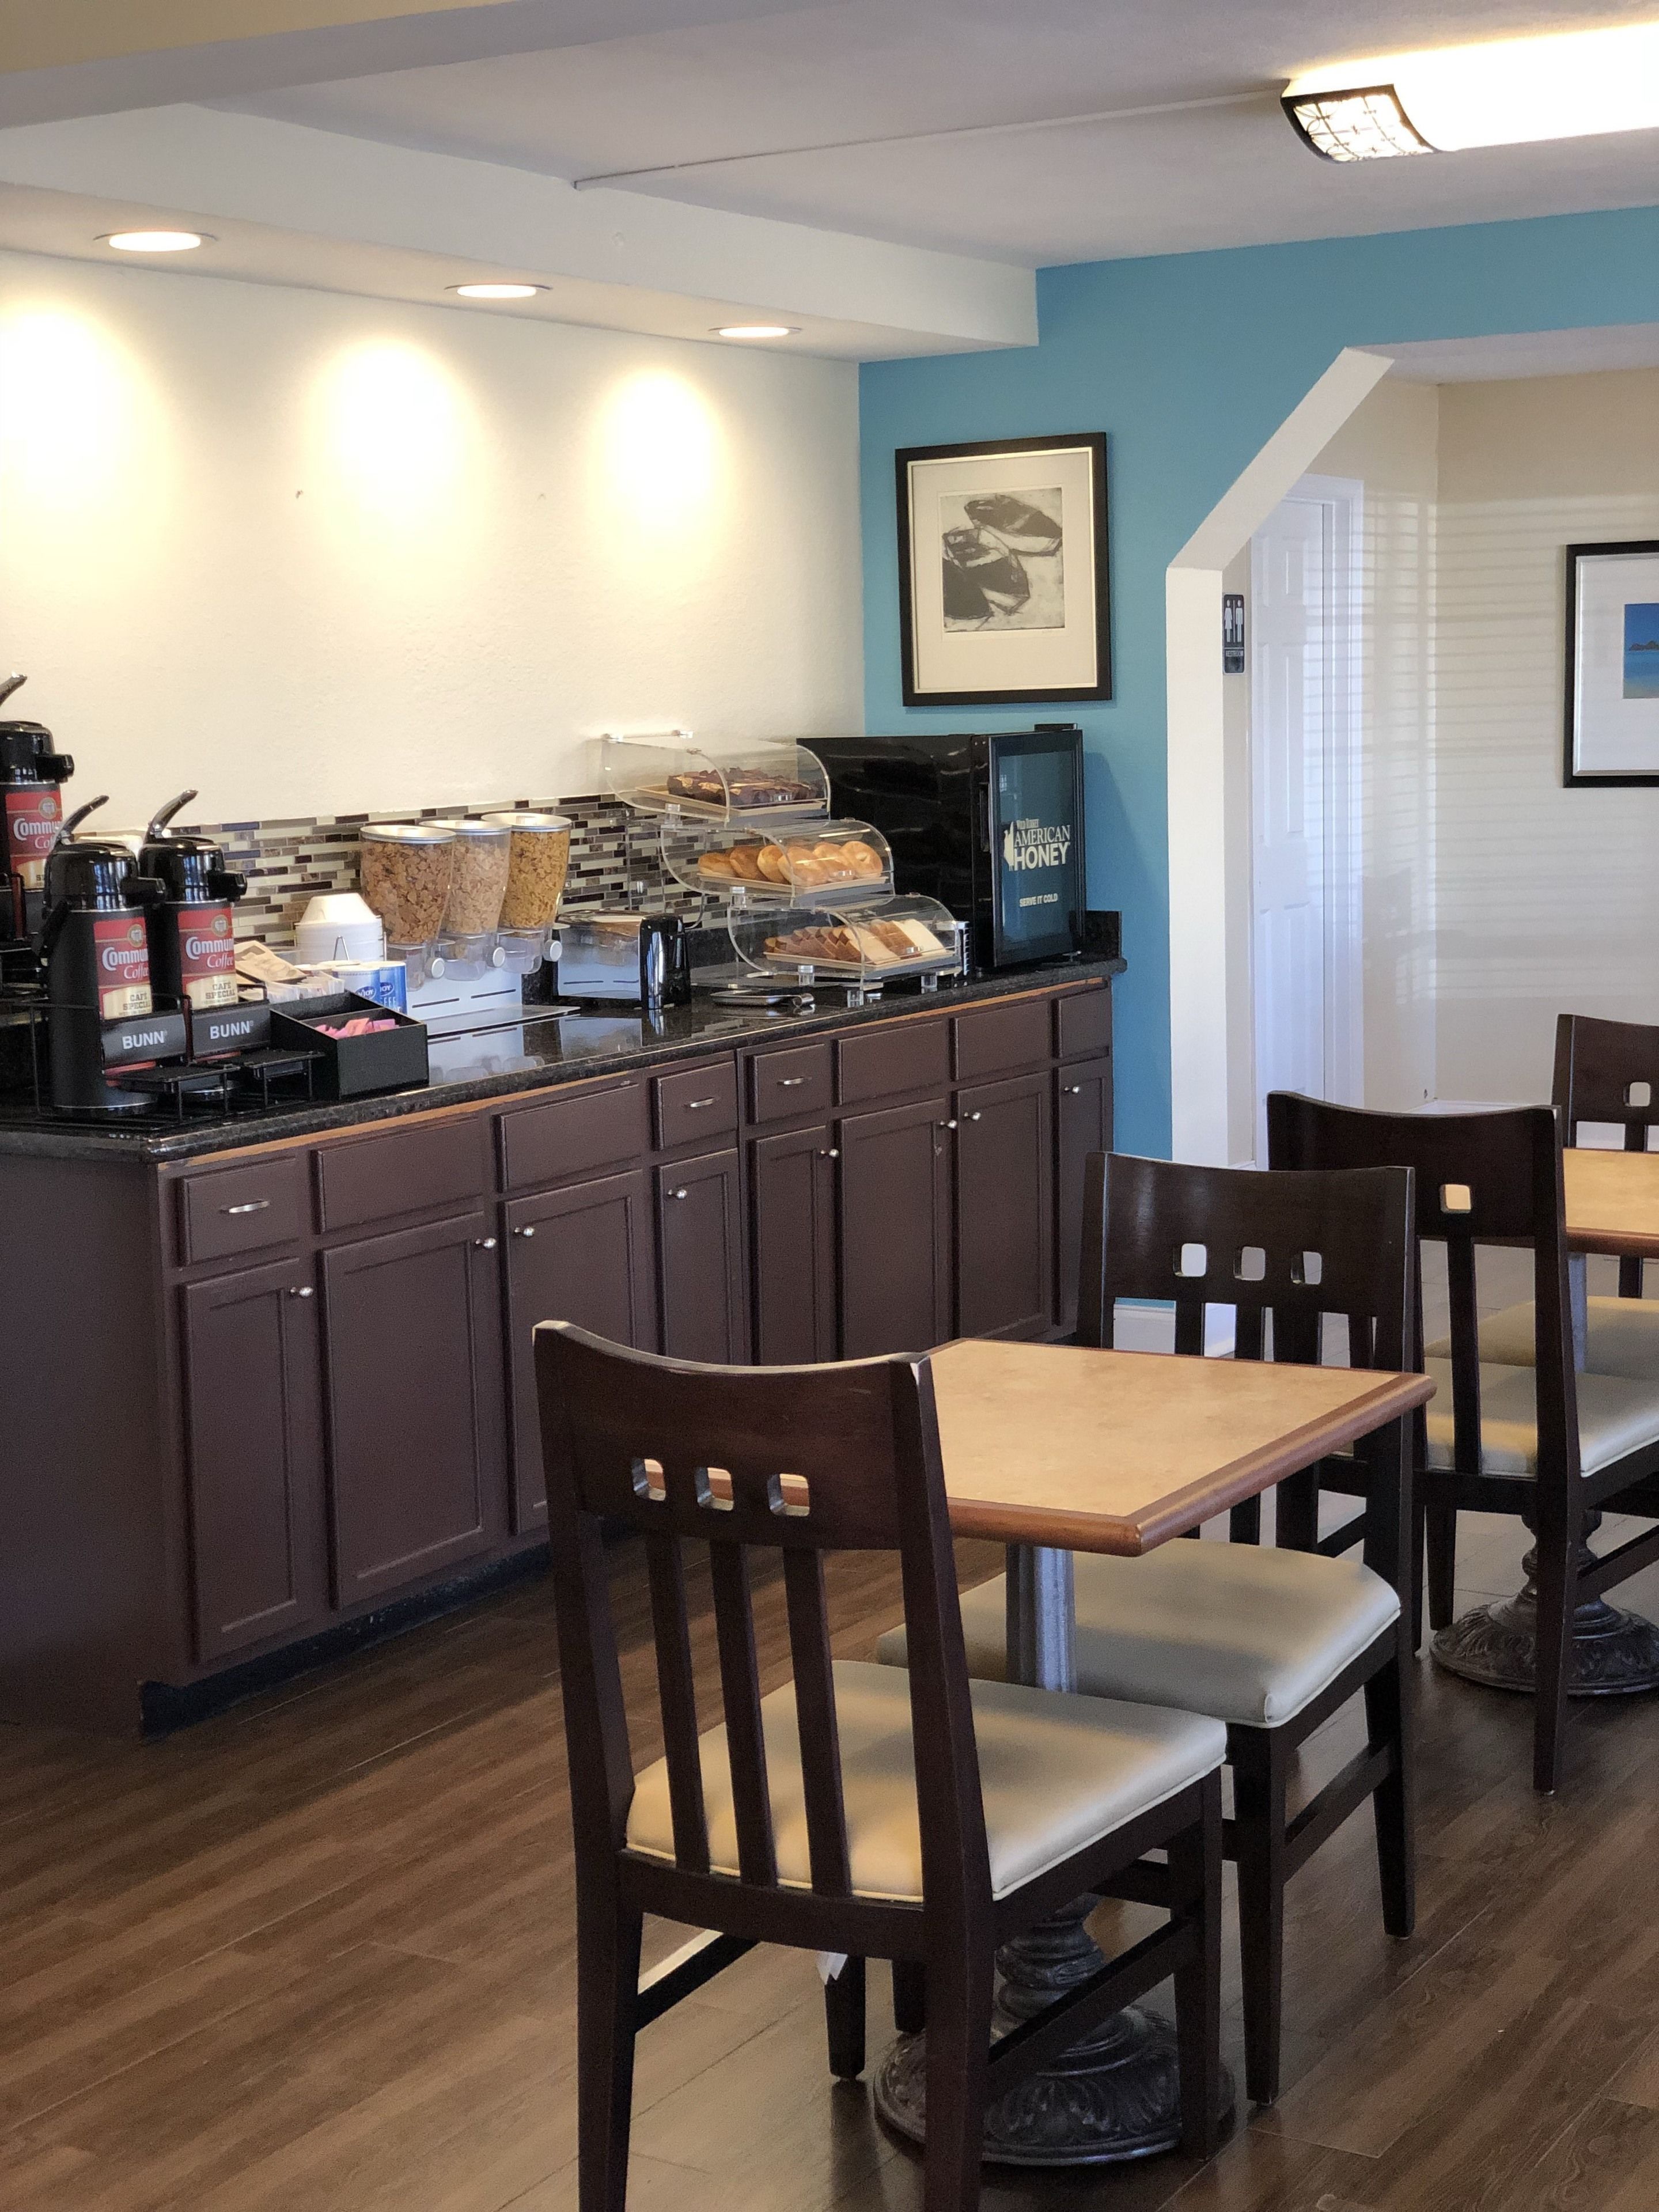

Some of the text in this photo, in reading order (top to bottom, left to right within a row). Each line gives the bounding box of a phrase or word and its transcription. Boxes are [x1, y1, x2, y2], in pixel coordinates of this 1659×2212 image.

[1014, 825, 1071, 847] AMERICAN
[1014, 842, 1070, 872] HONEY
[1020, 893, 1058, 907] SERVE IT COLD
